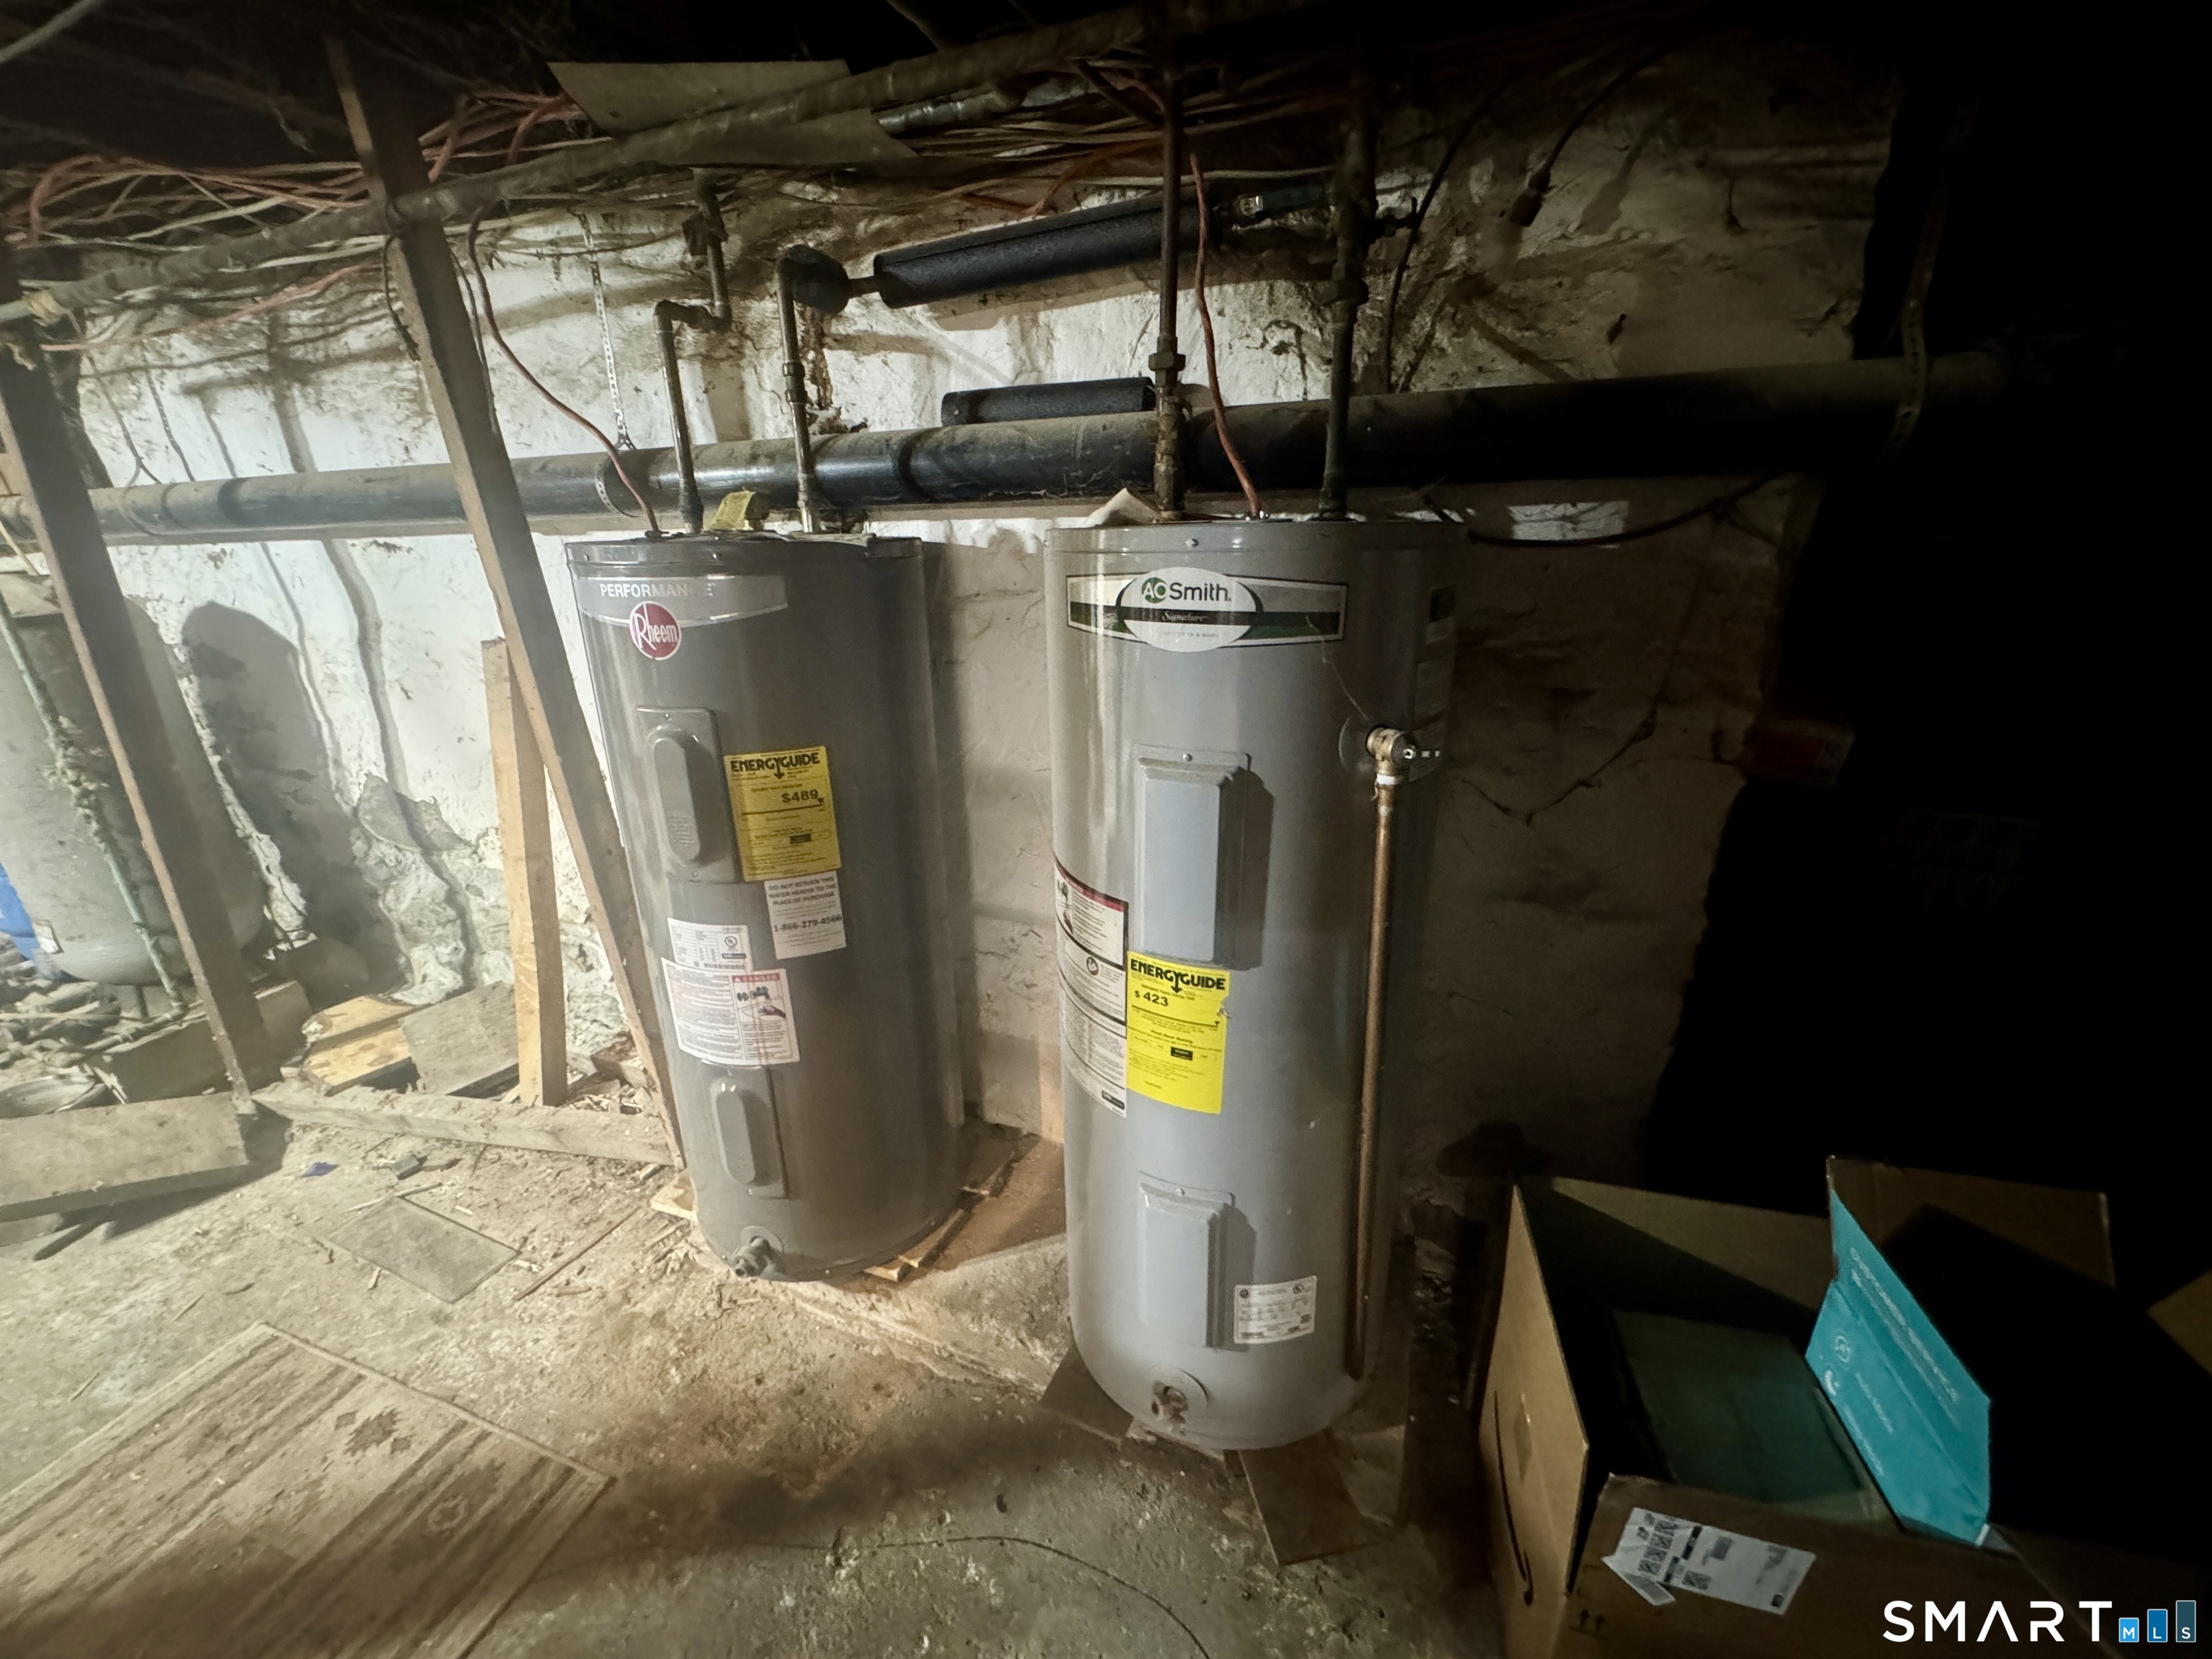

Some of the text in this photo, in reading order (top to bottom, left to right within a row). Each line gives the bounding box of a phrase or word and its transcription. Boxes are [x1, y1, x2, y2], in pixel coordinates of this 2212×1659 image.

[634, 603, 678, 651] Rheem
[781, 789, 819, 803] $489
[1143, 992, 1168, 1007] 423
